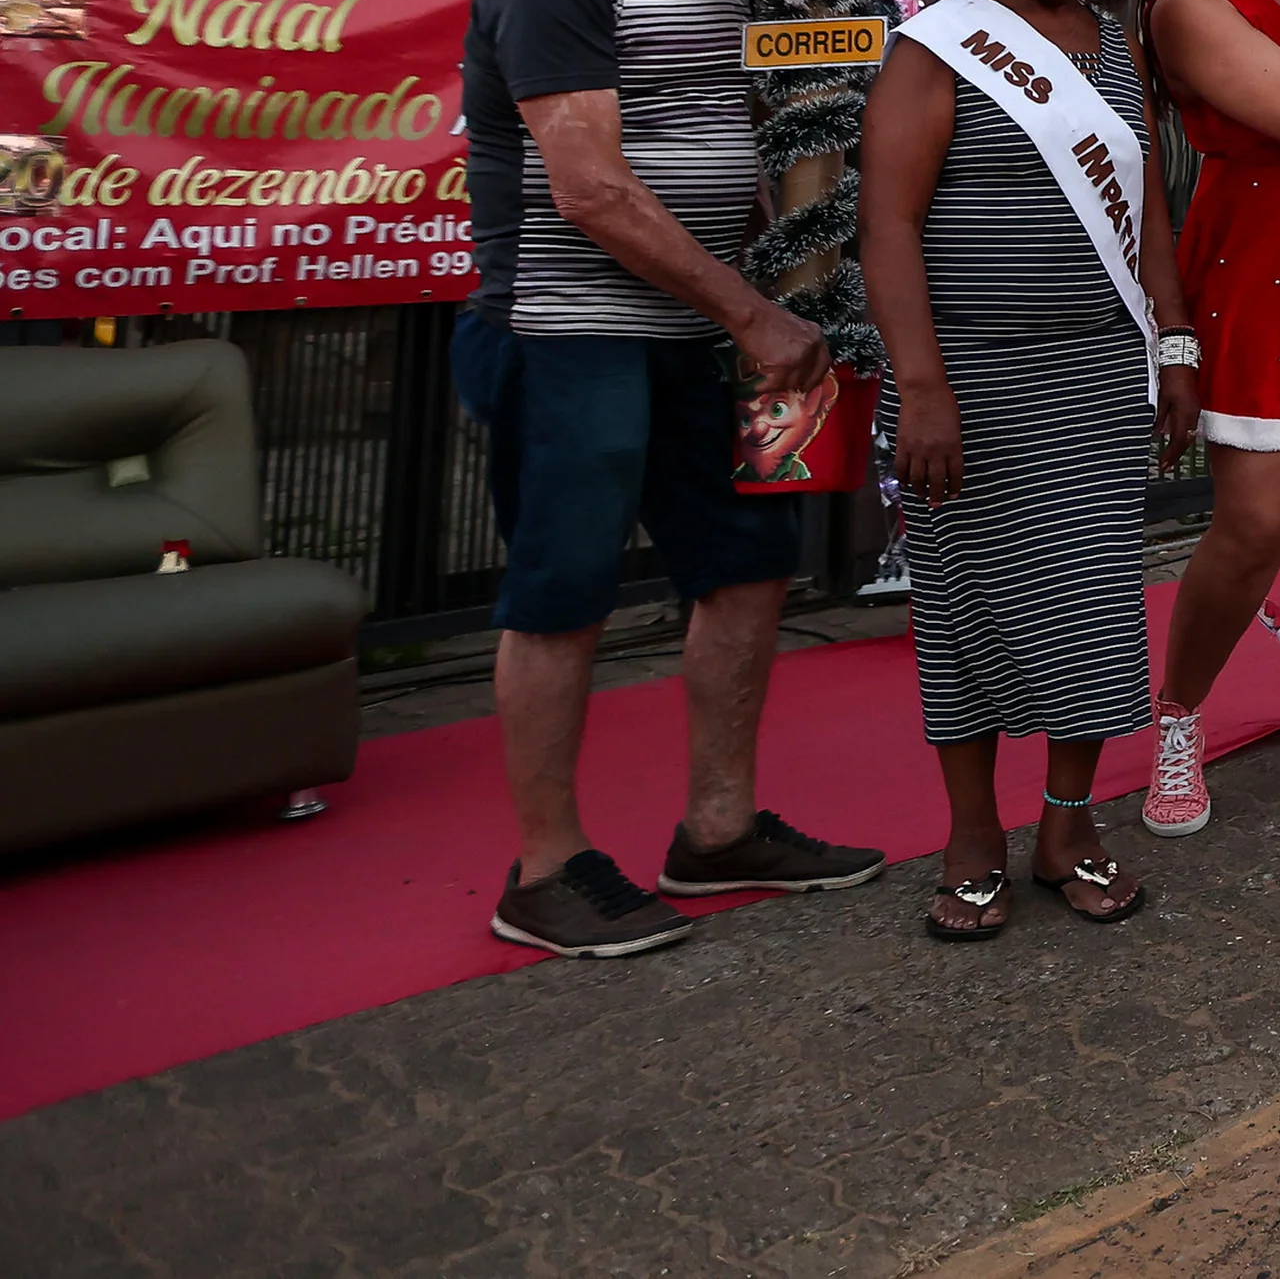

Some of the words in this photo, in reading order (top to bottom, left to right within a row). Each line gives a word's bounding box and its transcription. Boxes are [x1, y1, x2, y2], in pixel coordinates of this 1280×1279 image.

[756, 28, 873, 59] CORREIO
[961, 29, 1053, 105] MISS
[38, 61, 442, 142] Iluminado
[60, 154, 140, 206] de
[148, 155, 427, 207] dezembro
[437, 157, 472, 205] à
[0, 218, 128, 251] ocal:
[139, 218, 257, 257] Aqui
[271, 223, 332, 247] no
[0, 262, 60, 290] es
[75, 266, 173, 288] com
[184, 256, 284, 285] Prof.
[295, 254, 419, 280] Hellen
[430, 251, 481, 276] 99
